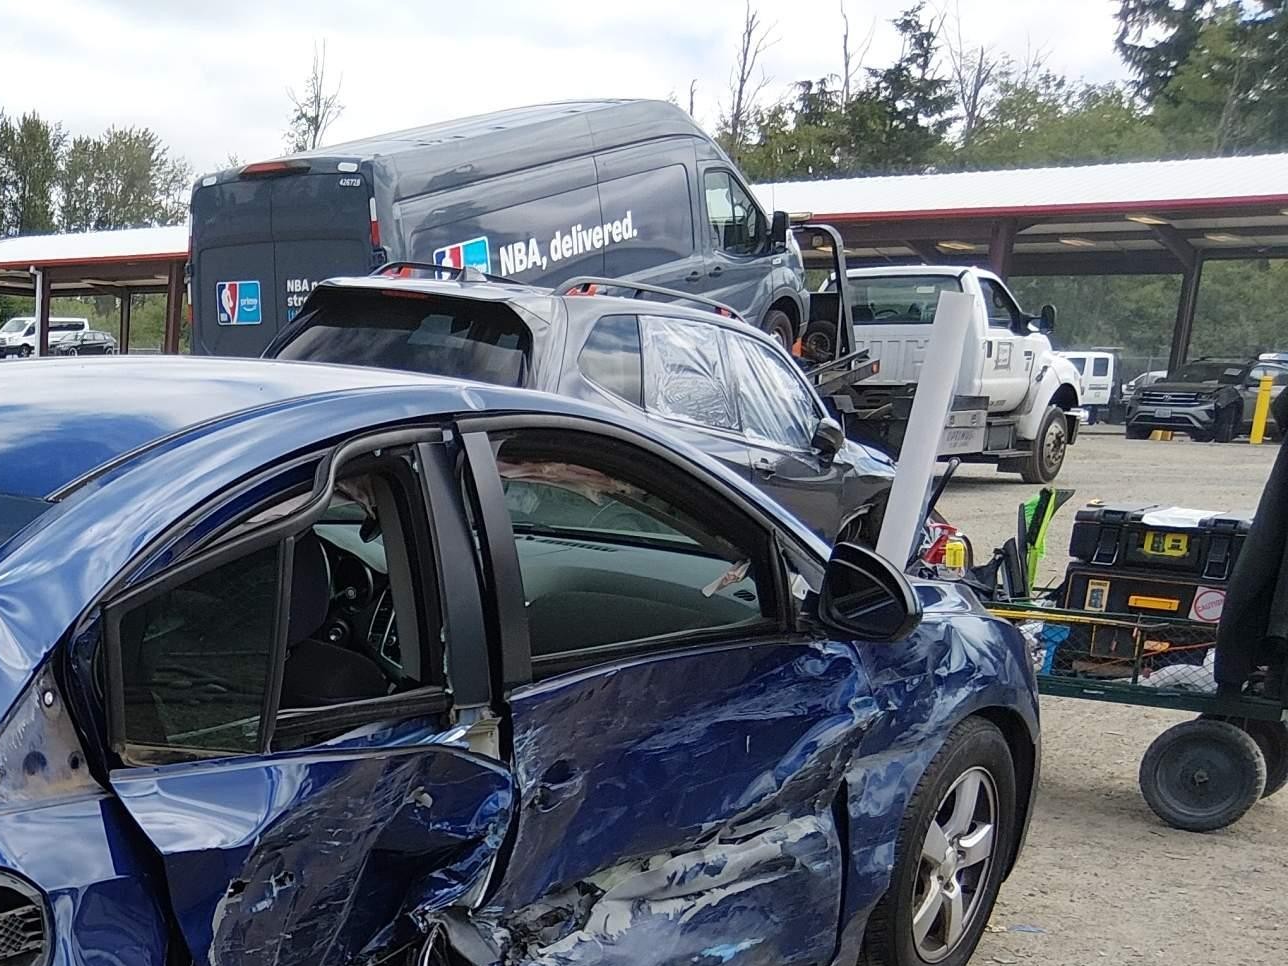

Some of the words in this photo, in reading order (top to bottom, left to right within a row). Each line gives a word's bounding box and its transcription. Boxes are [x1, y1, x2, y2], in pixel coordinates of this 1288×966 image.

[499, 238, 547, 276] NBA,
[550, 210, 638, 262] delivered.
[286, 279, 309, 292] NBA
